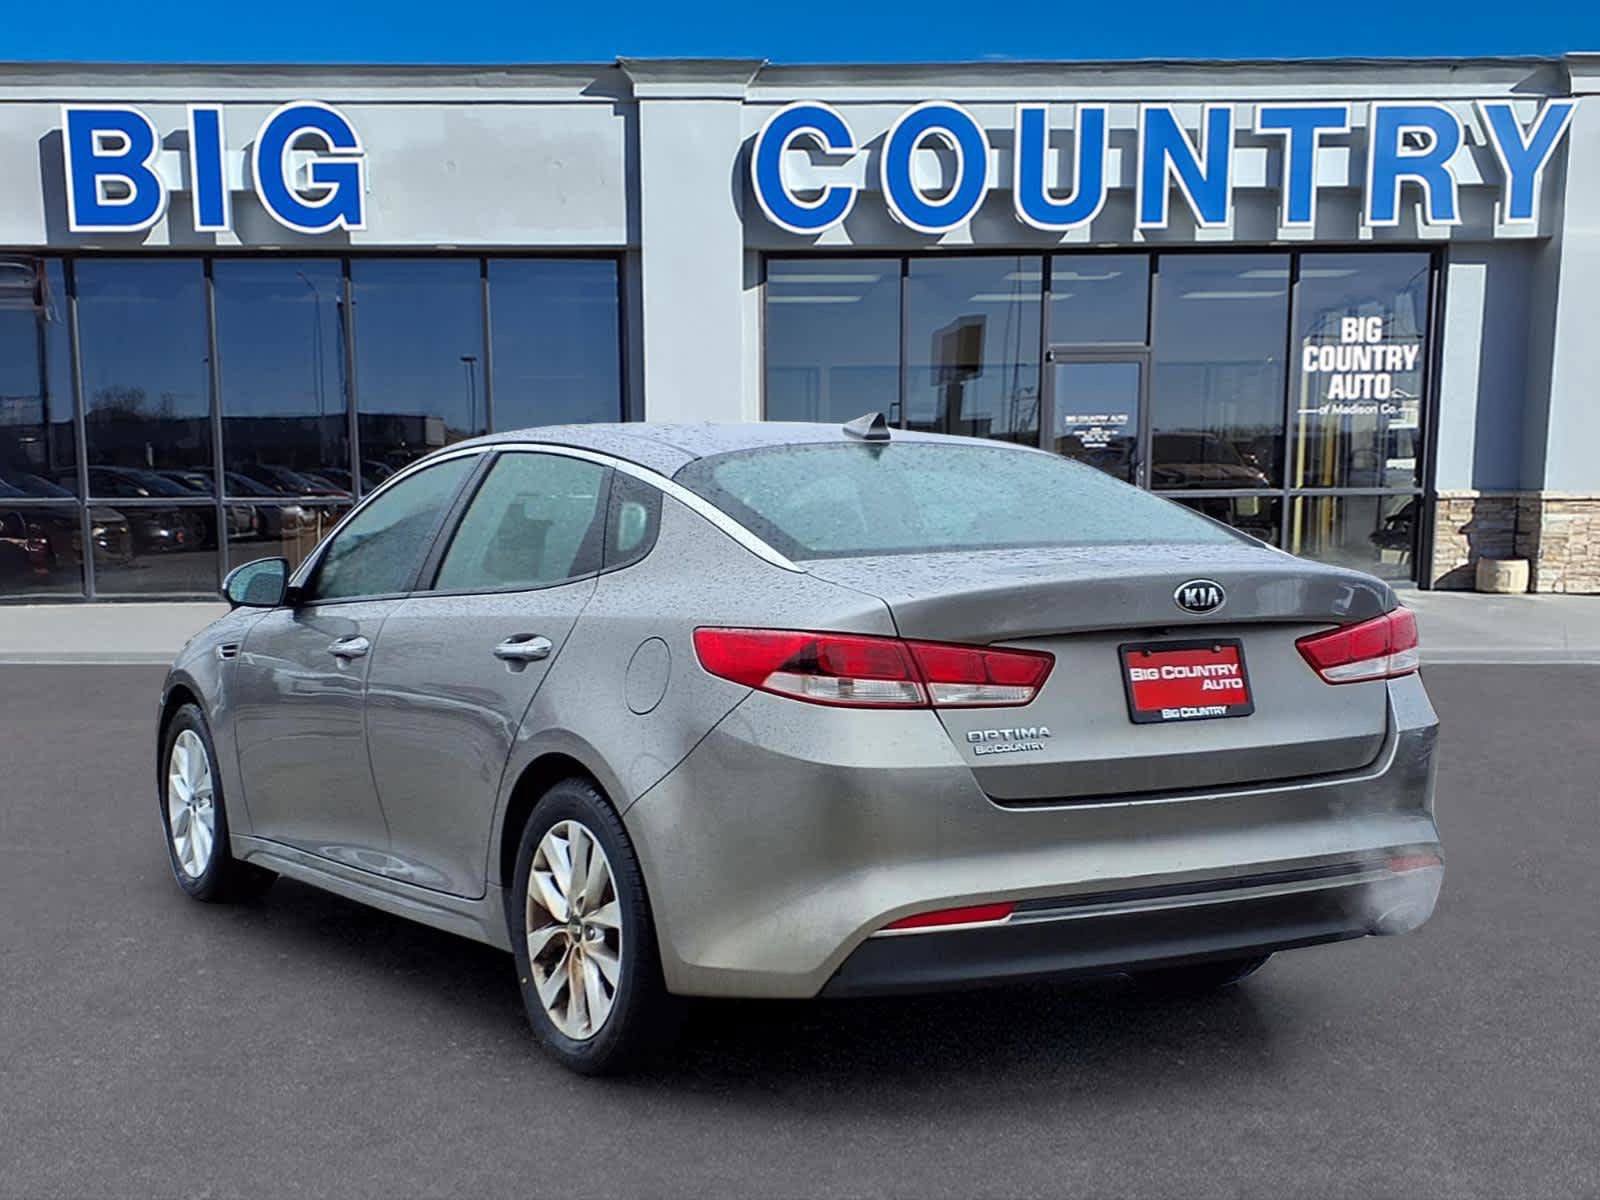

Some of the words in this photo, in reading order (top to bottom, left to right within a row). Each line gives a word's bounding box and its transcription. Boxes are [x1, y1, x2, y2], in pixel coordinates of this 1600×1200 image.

[61, 100, 367, 234] BIG
[751, 99, 1579, 235] COUNTRY
[1341, 316, 1383, 343] BIG
[1303, 344, 1420, 372] COUNTRY
[1327, 373, 1392, 399] AUTO
[1319, 402, 1330, 414] of
[1331, 403, 1378, 415] Madison
[1183, 587, 1219, 607] KIA
[1129, 667, 1160, 682] BIG
[1161, 663, 1239, 680] COUNTRY
[1202, 678, 1243, 691] AUTO
[1161, 708, 1180, 719] BIG
[1181, 705, 1228, 718] COUNTRY
[967, 726, 1051, 743] OPTIMA
